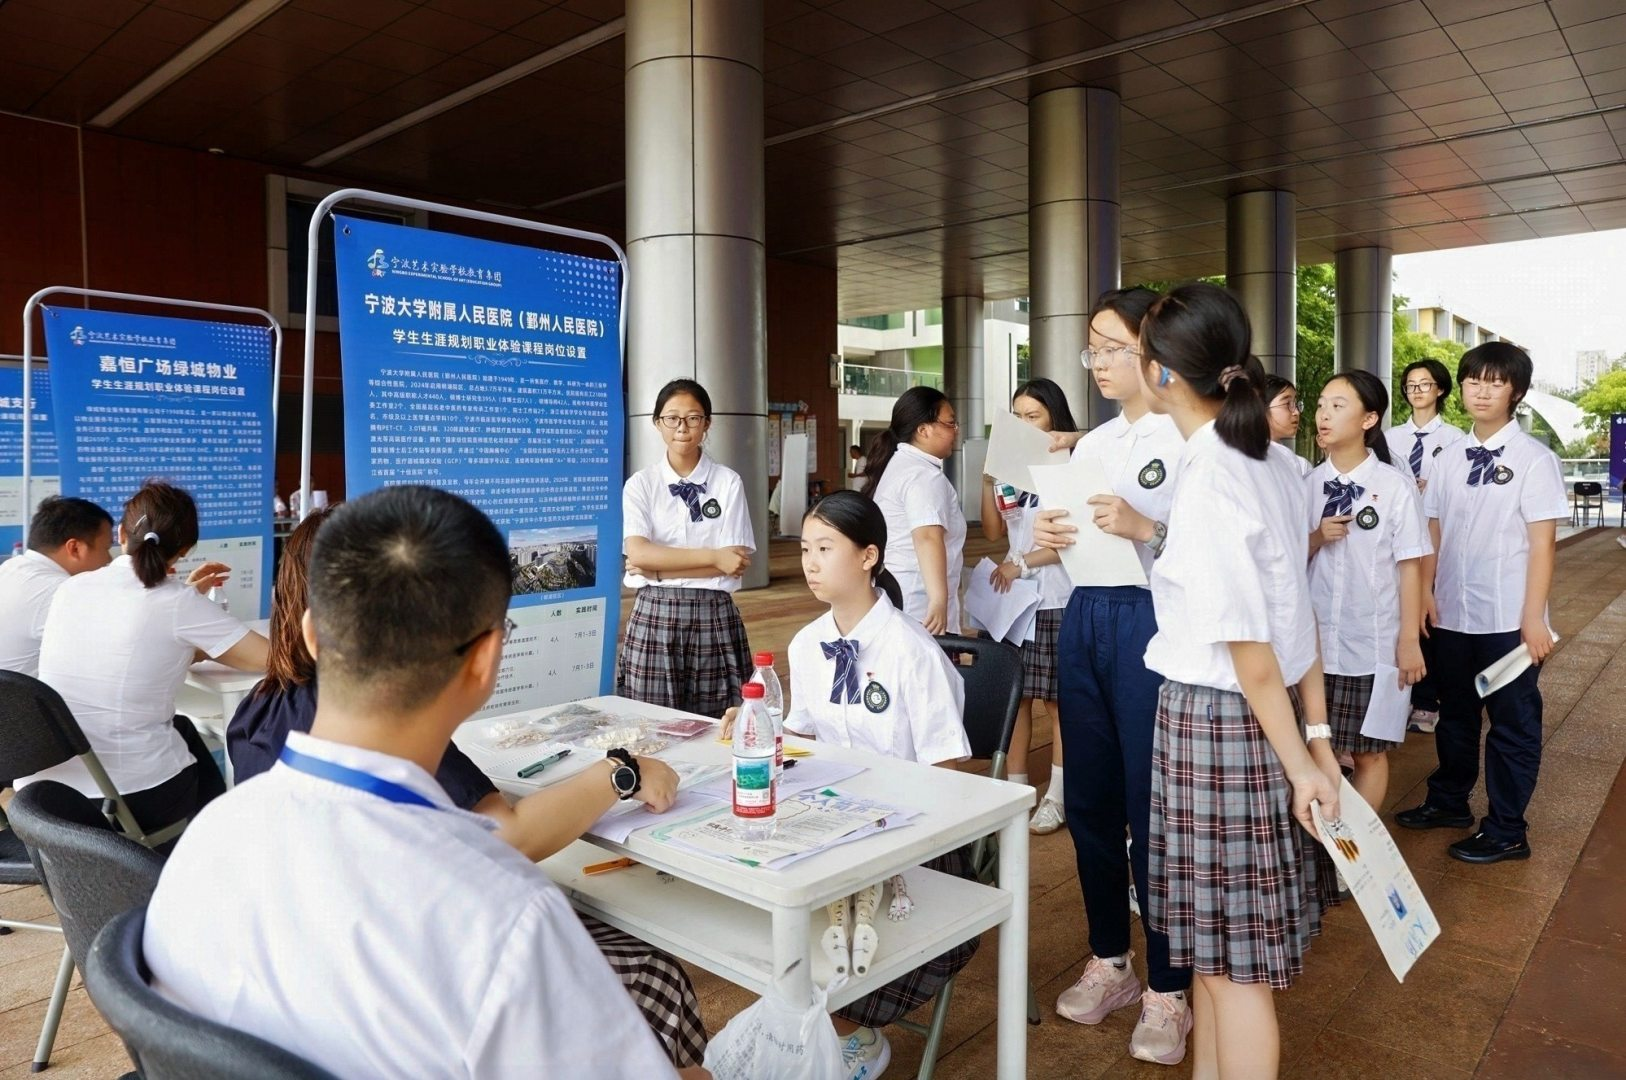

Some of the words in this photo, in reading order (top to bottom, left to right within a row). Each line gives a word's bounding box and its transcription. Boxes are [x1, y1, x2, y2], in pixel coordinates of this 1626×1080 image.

[391, 256, 502, 283] 宁波艺术实验学校教育集团
[364, 293, 605, 337] 宁波大学附属人民医院（鄞州人民医院）
[392, 329, 587, 359] 学生生涯规划职业体验课程岗位设置
[99, 355, 238, 380] 嘉恒广场绿城物业
[91, 378, 246, 396] 学生生涯规划职业体验课程岗位设置
